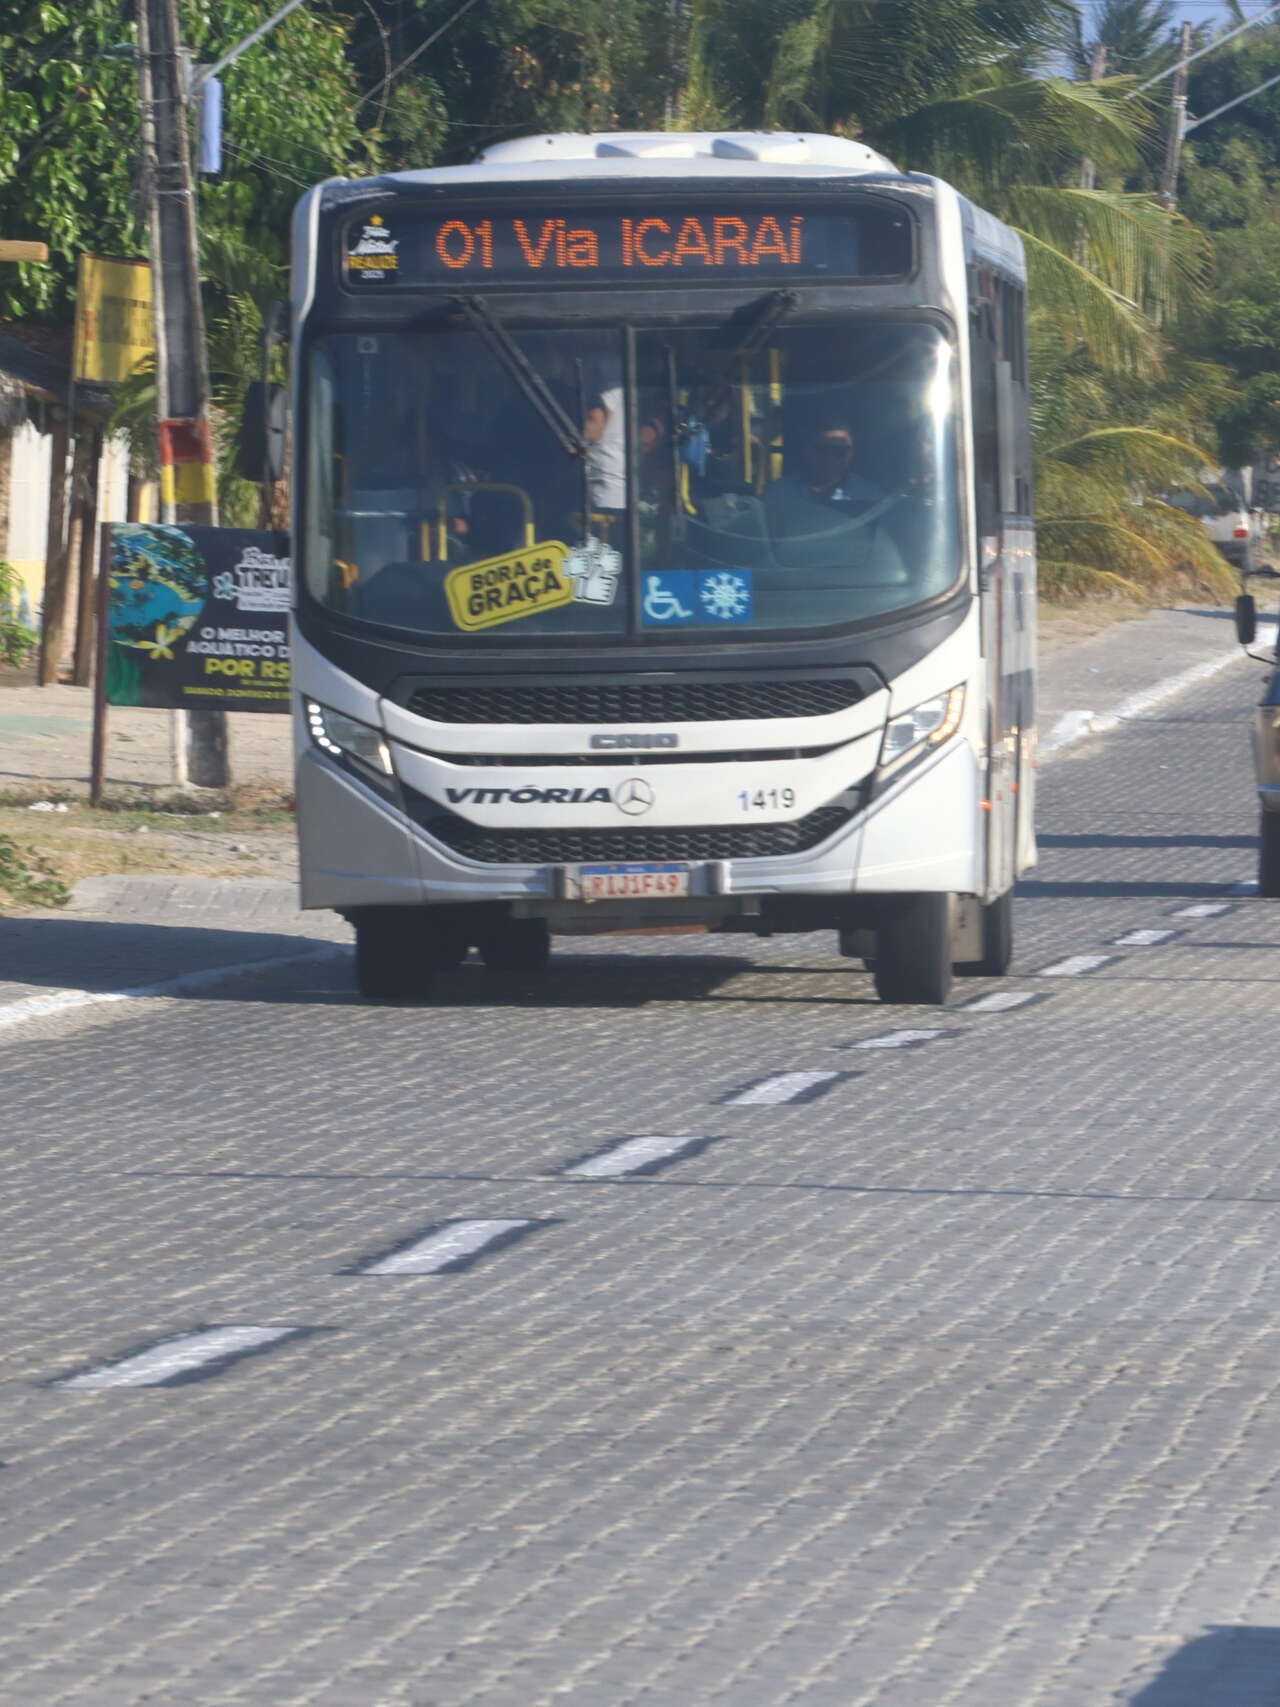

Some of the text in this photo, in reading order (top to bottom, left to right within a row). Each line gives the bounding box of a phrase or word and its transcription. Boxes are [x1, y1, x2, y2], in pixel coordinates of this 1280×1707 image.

[436, 219, 494, 268] 01
[512, 219, 599, 268] Via
[471, 559, 552, 592] BORA de
[468, 570, 563, 616] GRAÇA
[200, 627, 285, 643] O MELHOR
[205, 658, 257, 677] POR
[590, 733, 679, 749] CAIO
[444, 785, 615, 804] VITÓRIA
[737, 788, 796, 811] 1419
